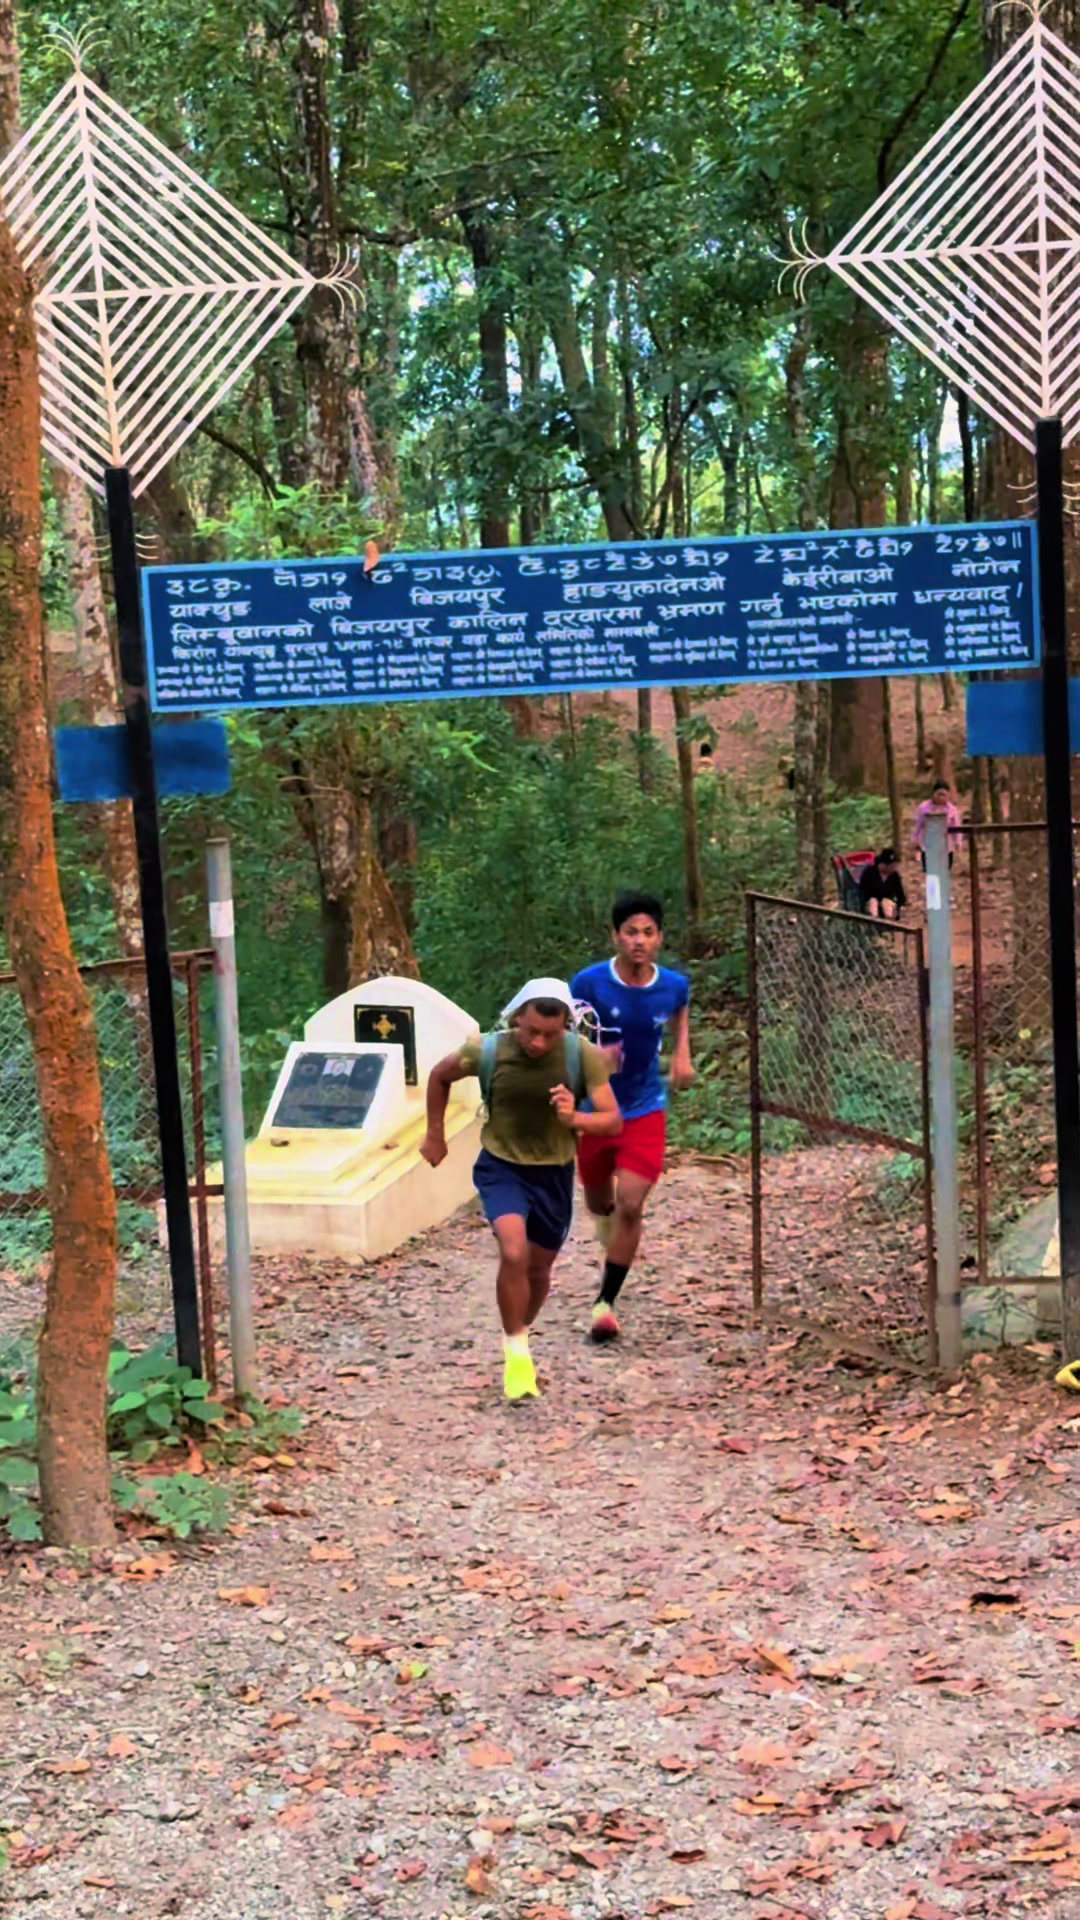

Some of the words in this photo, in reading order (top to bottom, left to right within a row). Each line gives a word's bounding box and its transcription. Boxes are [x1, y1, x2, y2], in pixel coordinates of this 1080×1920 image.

[330, 616, 433, 637] बिजयपुर
[449, 609, 527, 628] कालिन
[658, 602, 725, 620] भ्रमण
[740, 593, 784, 618] गर्नु
[799, 589, 897, 609] भएकोमा
[913, 586, 1010, 605] धन्यवाद
[410, 582, 505, 610] बिजयपुर
